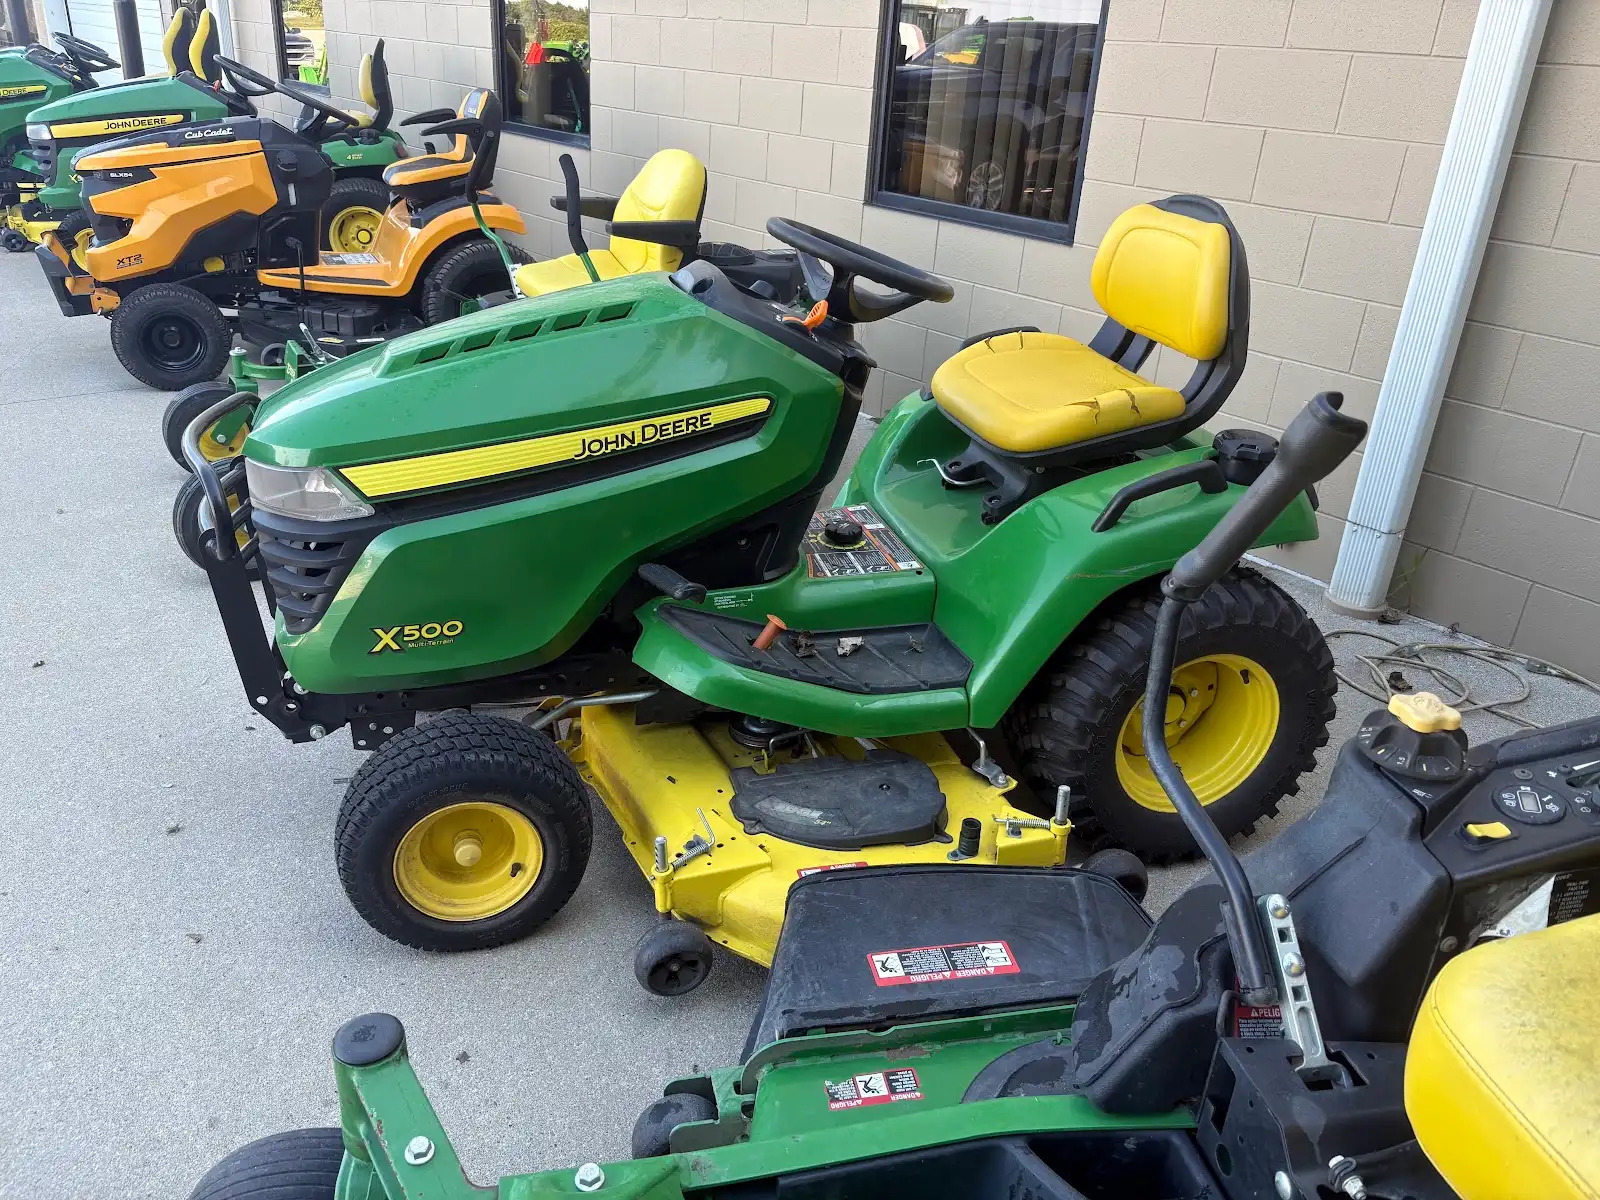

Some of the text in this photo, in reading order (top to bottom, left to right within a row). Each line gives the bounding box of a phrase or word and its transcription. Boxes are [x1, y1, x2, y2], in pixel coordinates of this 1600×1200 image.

[104, 117, 167, 130] JOHN DEERE
[184, 127, 234, 139] Cub Cadet
[116, 253, 142, 266] XT2
[573, 411, 712, 460] JOHN DEERE
[369, 619, 464, 654] X500
[407, 638, 455, 648] Multi-Terrain
[910, 967, 987, 983] PELIGRO DANGER
[1258, 1008, 1281, 1017] PELIG
[830, 1091, 916, 1109] PELIGRO DANGER
